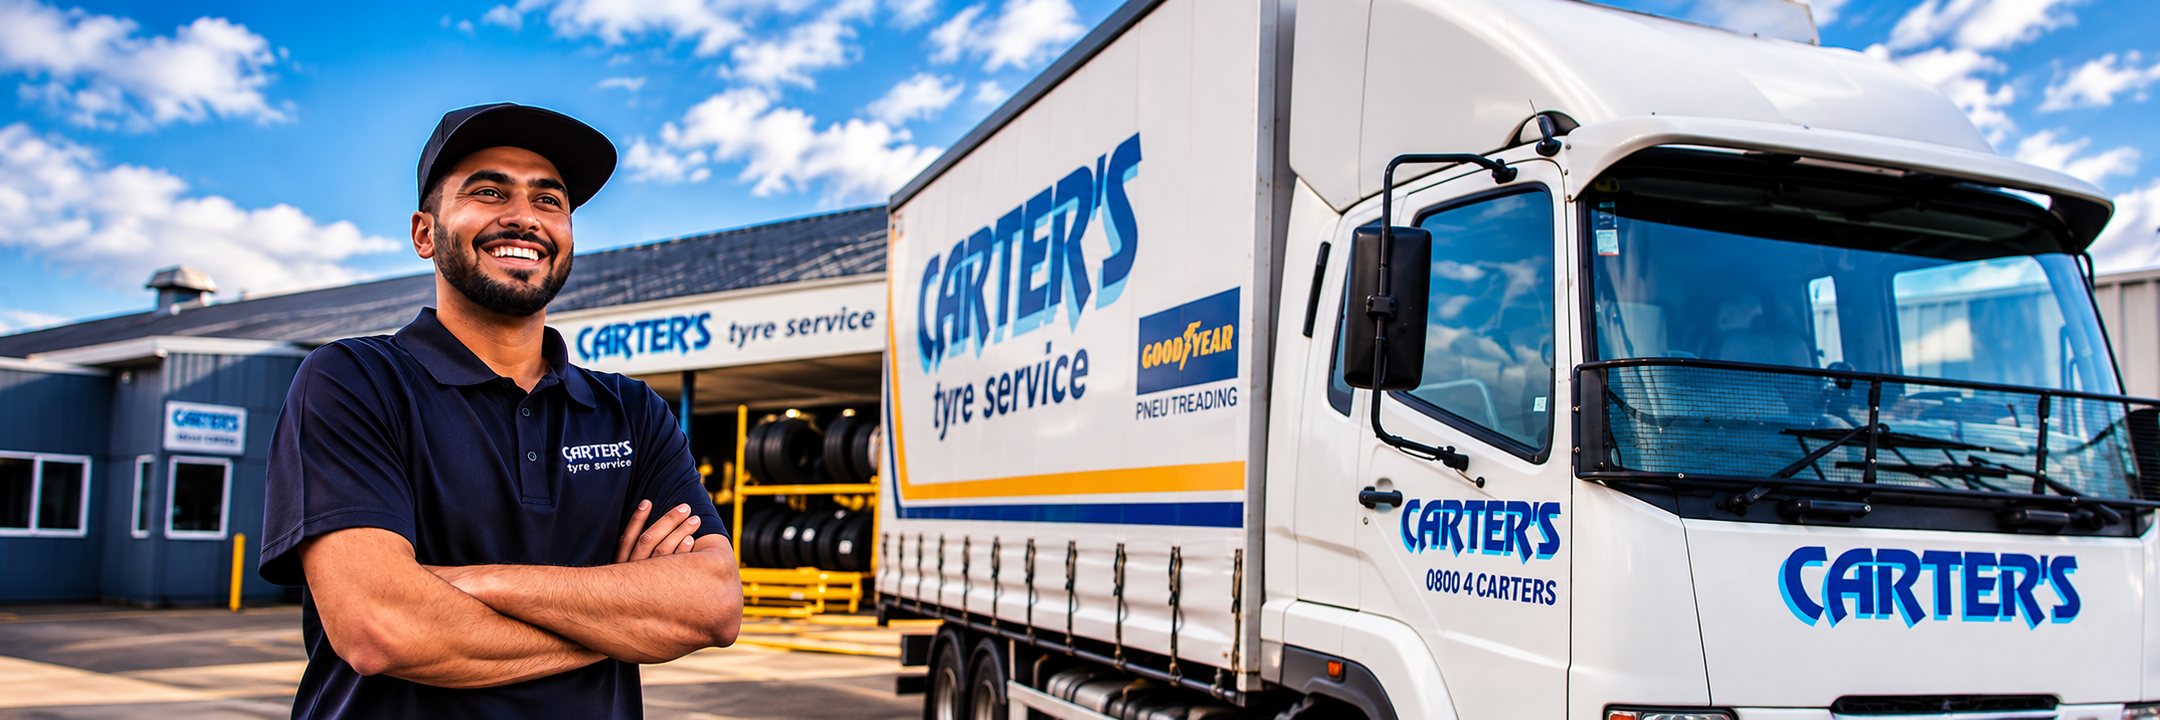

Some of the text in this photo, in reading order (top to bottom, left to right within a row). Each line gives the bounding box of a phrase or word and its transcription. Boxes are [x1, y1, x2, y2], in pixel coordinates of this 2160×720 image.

[917, 132, 1142, 375] CARTER'S
[577, 307, 876, 361] CARTER'S tyre service
[1141, 320, 1234, 371] GOODYEAR
[934, 340, 1088, 441] tyre service
[1136, 386, 1238, 420] PNEU TREADING
[562, 440, 632, 461] CARTER'S
[567, 458, 632, 473] tyre service
[1400, 499, 1561, 565] CARTER'S
[1426, 568, 1557, 606] 0800 4 CARTERS
[1778, 546, 2081, 631] CARTER'S
